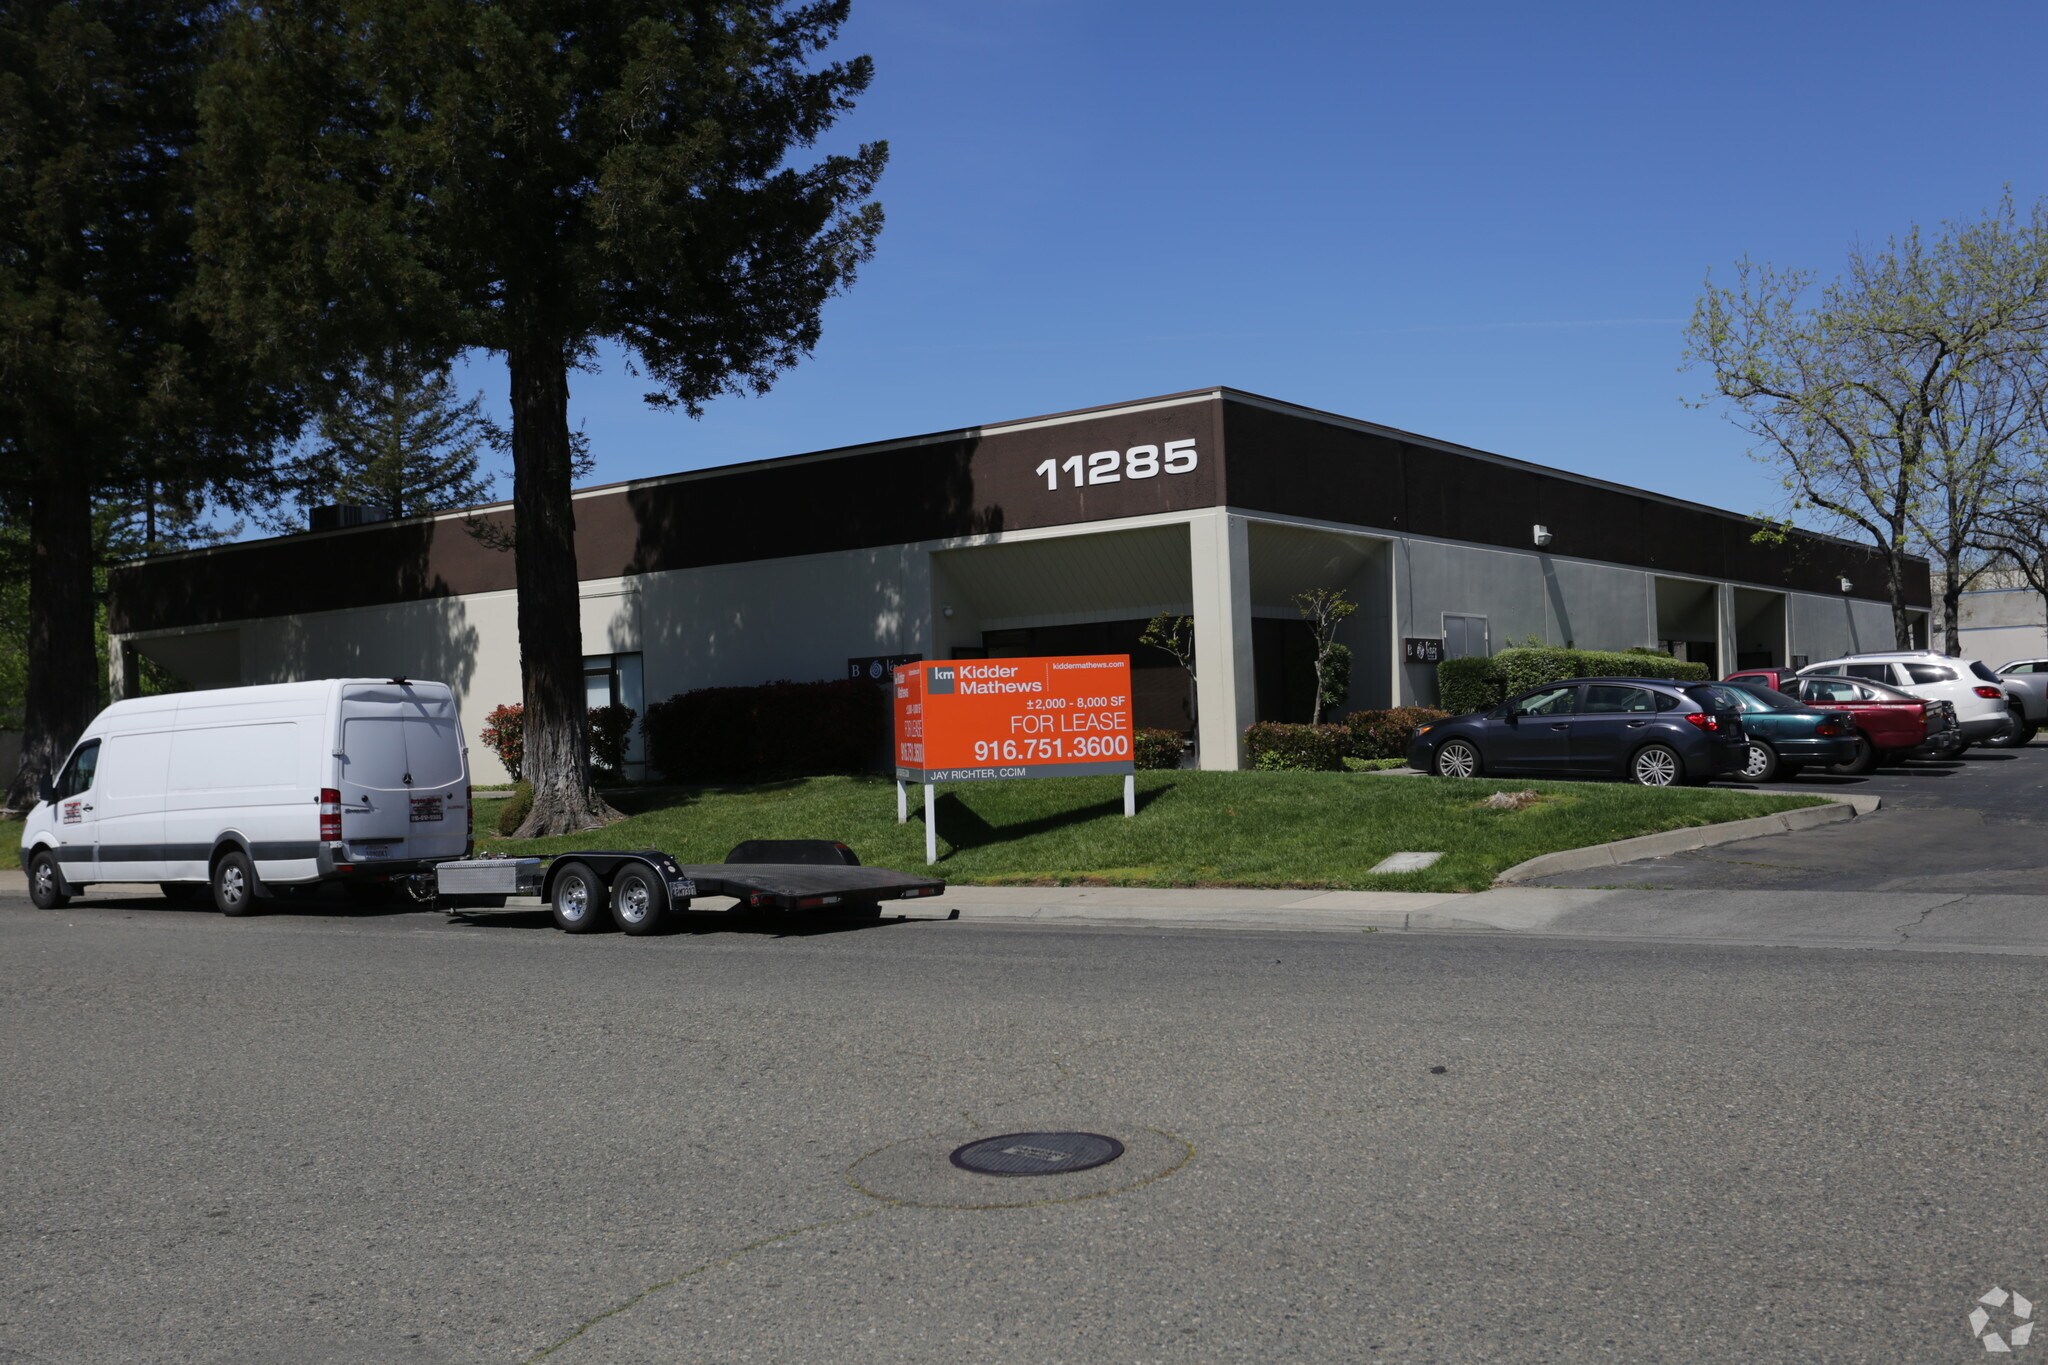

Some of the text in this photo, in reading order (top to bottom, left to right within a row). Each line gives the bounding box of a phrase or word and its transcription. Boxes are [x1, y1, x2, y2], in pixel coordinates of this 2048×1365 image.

[1035, 438, 1198, 491] 11285
[852, 664, 861, 678] B
[960, 665, 1018, 679] Kidder
[1053, 661, 1125, 670] kiddermathews.com
[935, 666, 955, 680] km
[960, 680, 1042, 695] Mathews
[1077, 697, 1107, 709] 8,000
[1111, 695, 1126, 707] SF
[1011, 712, 1127, 734] FOR LEASE
[974, 735, 1128, 761] 916.751.3600
[930, 768, 1026, 780] JAY RICHTER, CCIM
